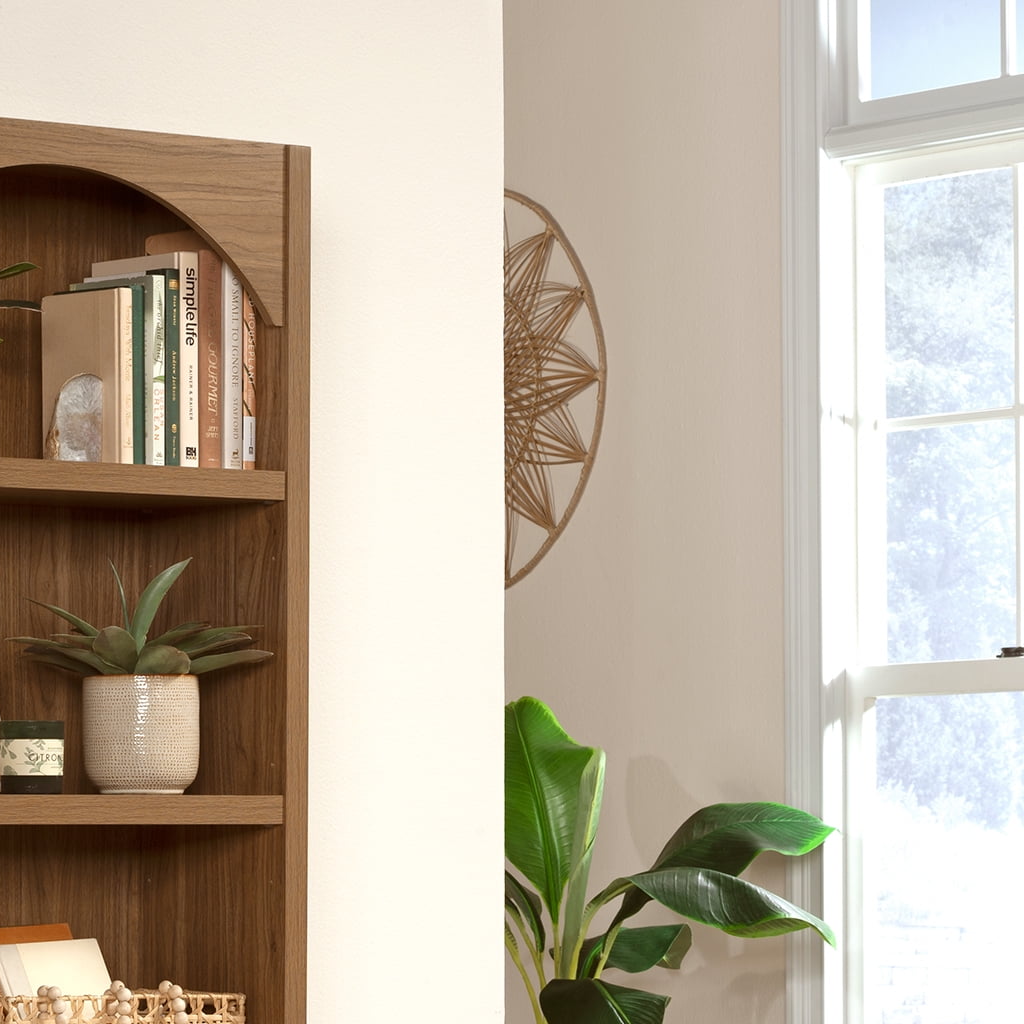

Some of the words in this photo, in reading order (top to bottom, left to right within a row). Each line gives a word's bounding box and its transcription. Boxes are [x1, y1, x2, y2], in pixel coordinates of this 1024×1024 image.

[231, 289, 240, 324] SMALL
[231, 327, 240, 342] TO
[208, 342, 218, 416] GOURMET
[231, 344, 239, 388] IGNORE
